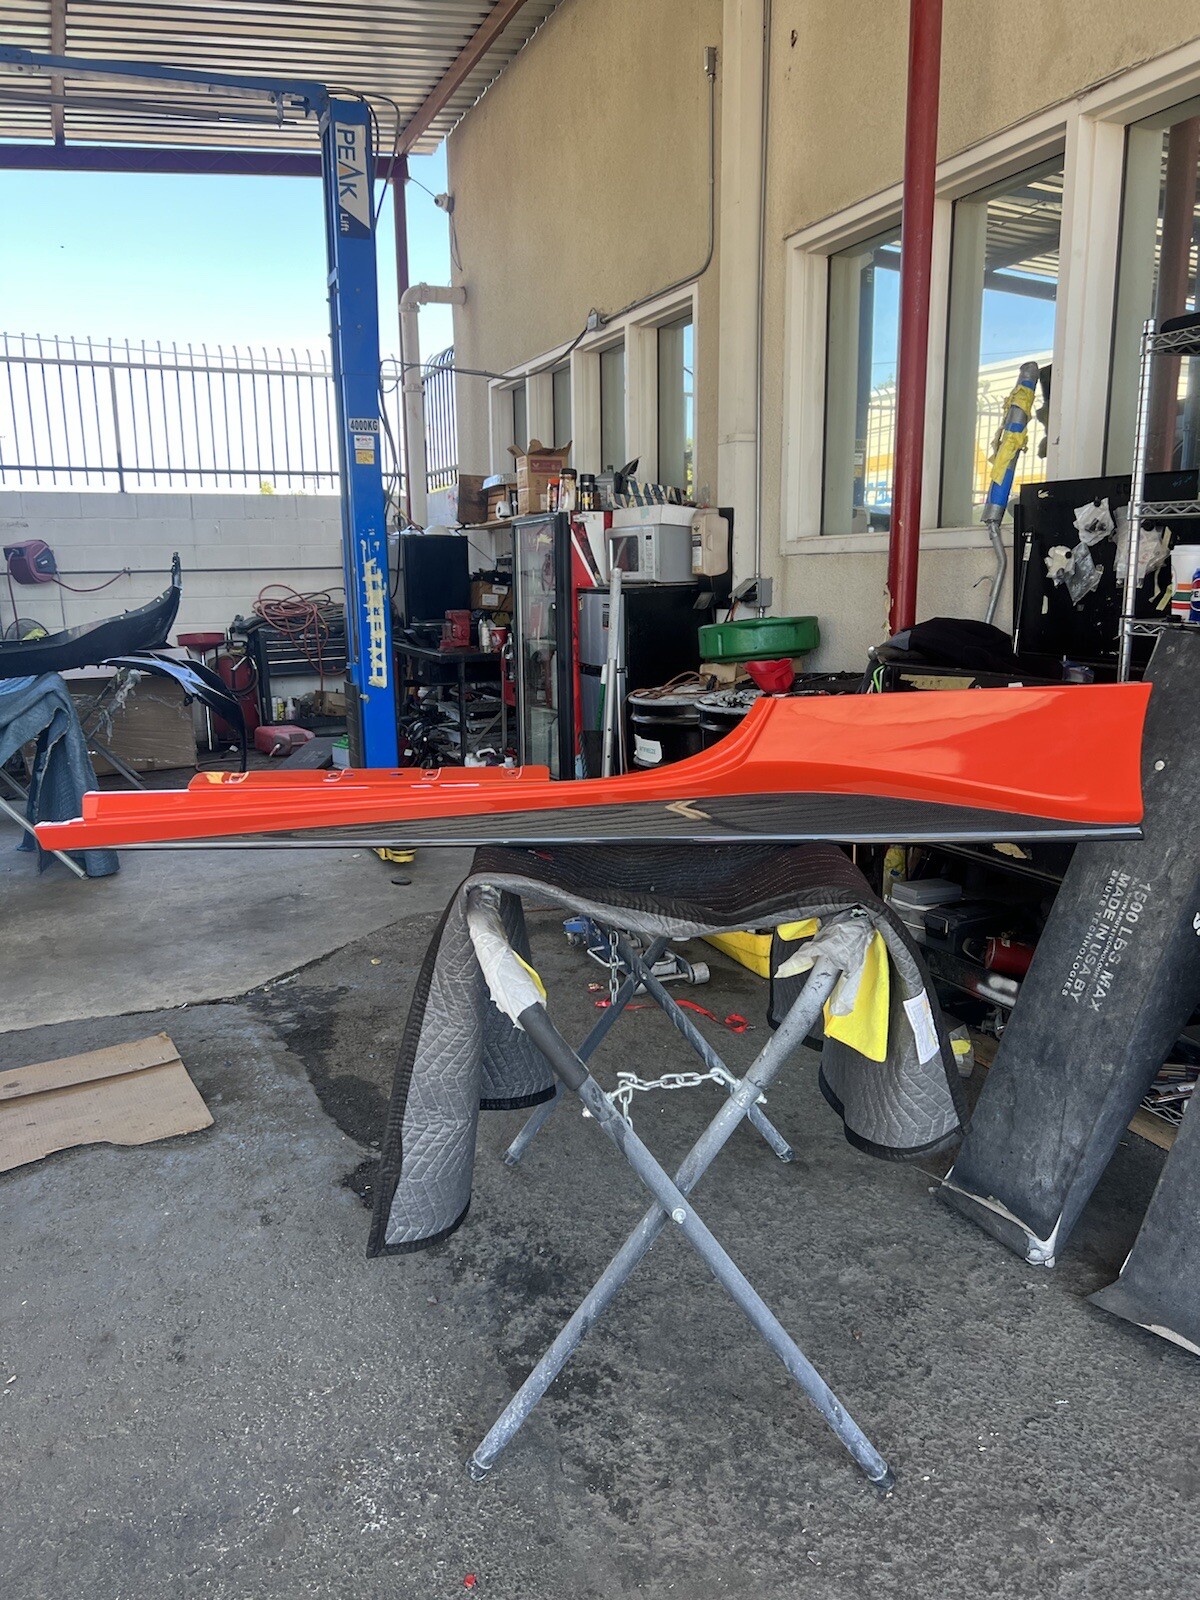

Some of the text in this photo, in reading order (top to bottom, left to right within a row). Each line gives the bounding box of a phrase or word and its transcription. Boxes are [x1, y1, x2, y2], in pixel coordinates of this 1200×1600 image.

[337, 128, 365, 232] PEAK Lift
[350, 419, 378, 431] 4000KG
[1061, 870, 1119, 996] BRUTE TECHNOLOGIES
[1070, 873, 1131, 1003] MADE IN USA BY
[1125, 883, 1151, 923] 1500
[1089, 970, 1114, 1011] MAX
